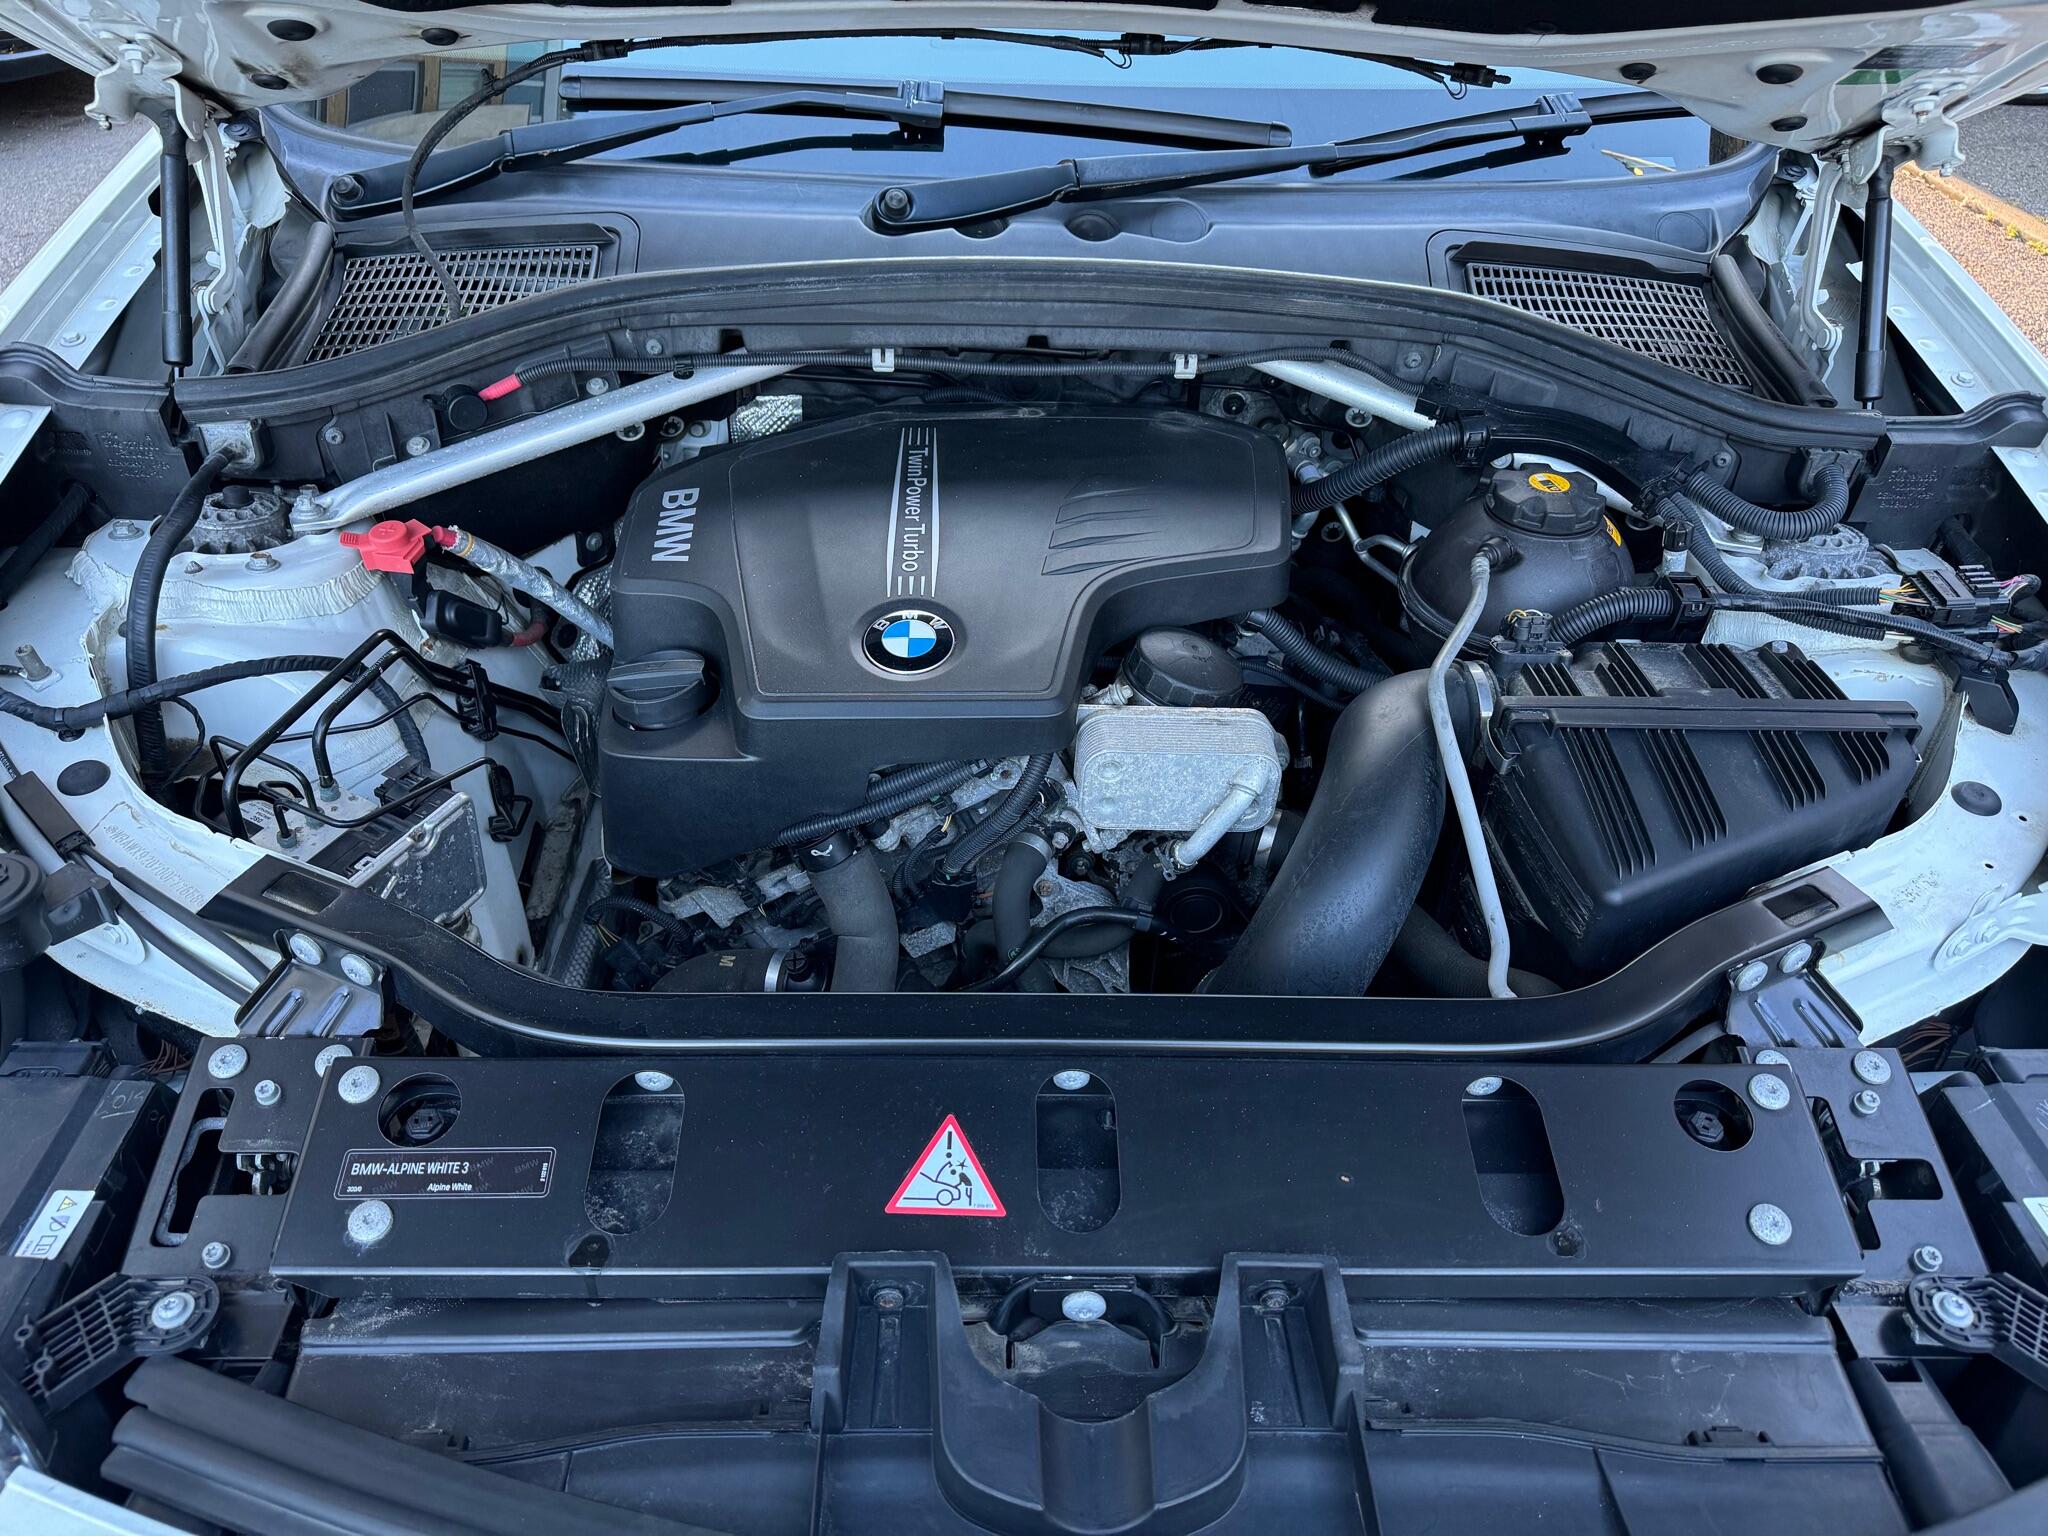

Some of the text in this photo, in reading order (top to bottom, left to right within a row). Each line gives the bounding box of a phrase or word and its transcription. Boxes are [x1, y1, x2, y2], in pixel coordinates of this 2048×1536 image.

[901, 447, 929, 573] TwinPower Turbo
[651, 488, 700, 562] BMW
[873, 612, 947, 632] BMW
[351, 1161, 470, 1176] BMW-ALPINE WHITE 3
[427, 1182, 451, 1193] Alpine
[451, 1182, 473, 1192] White
